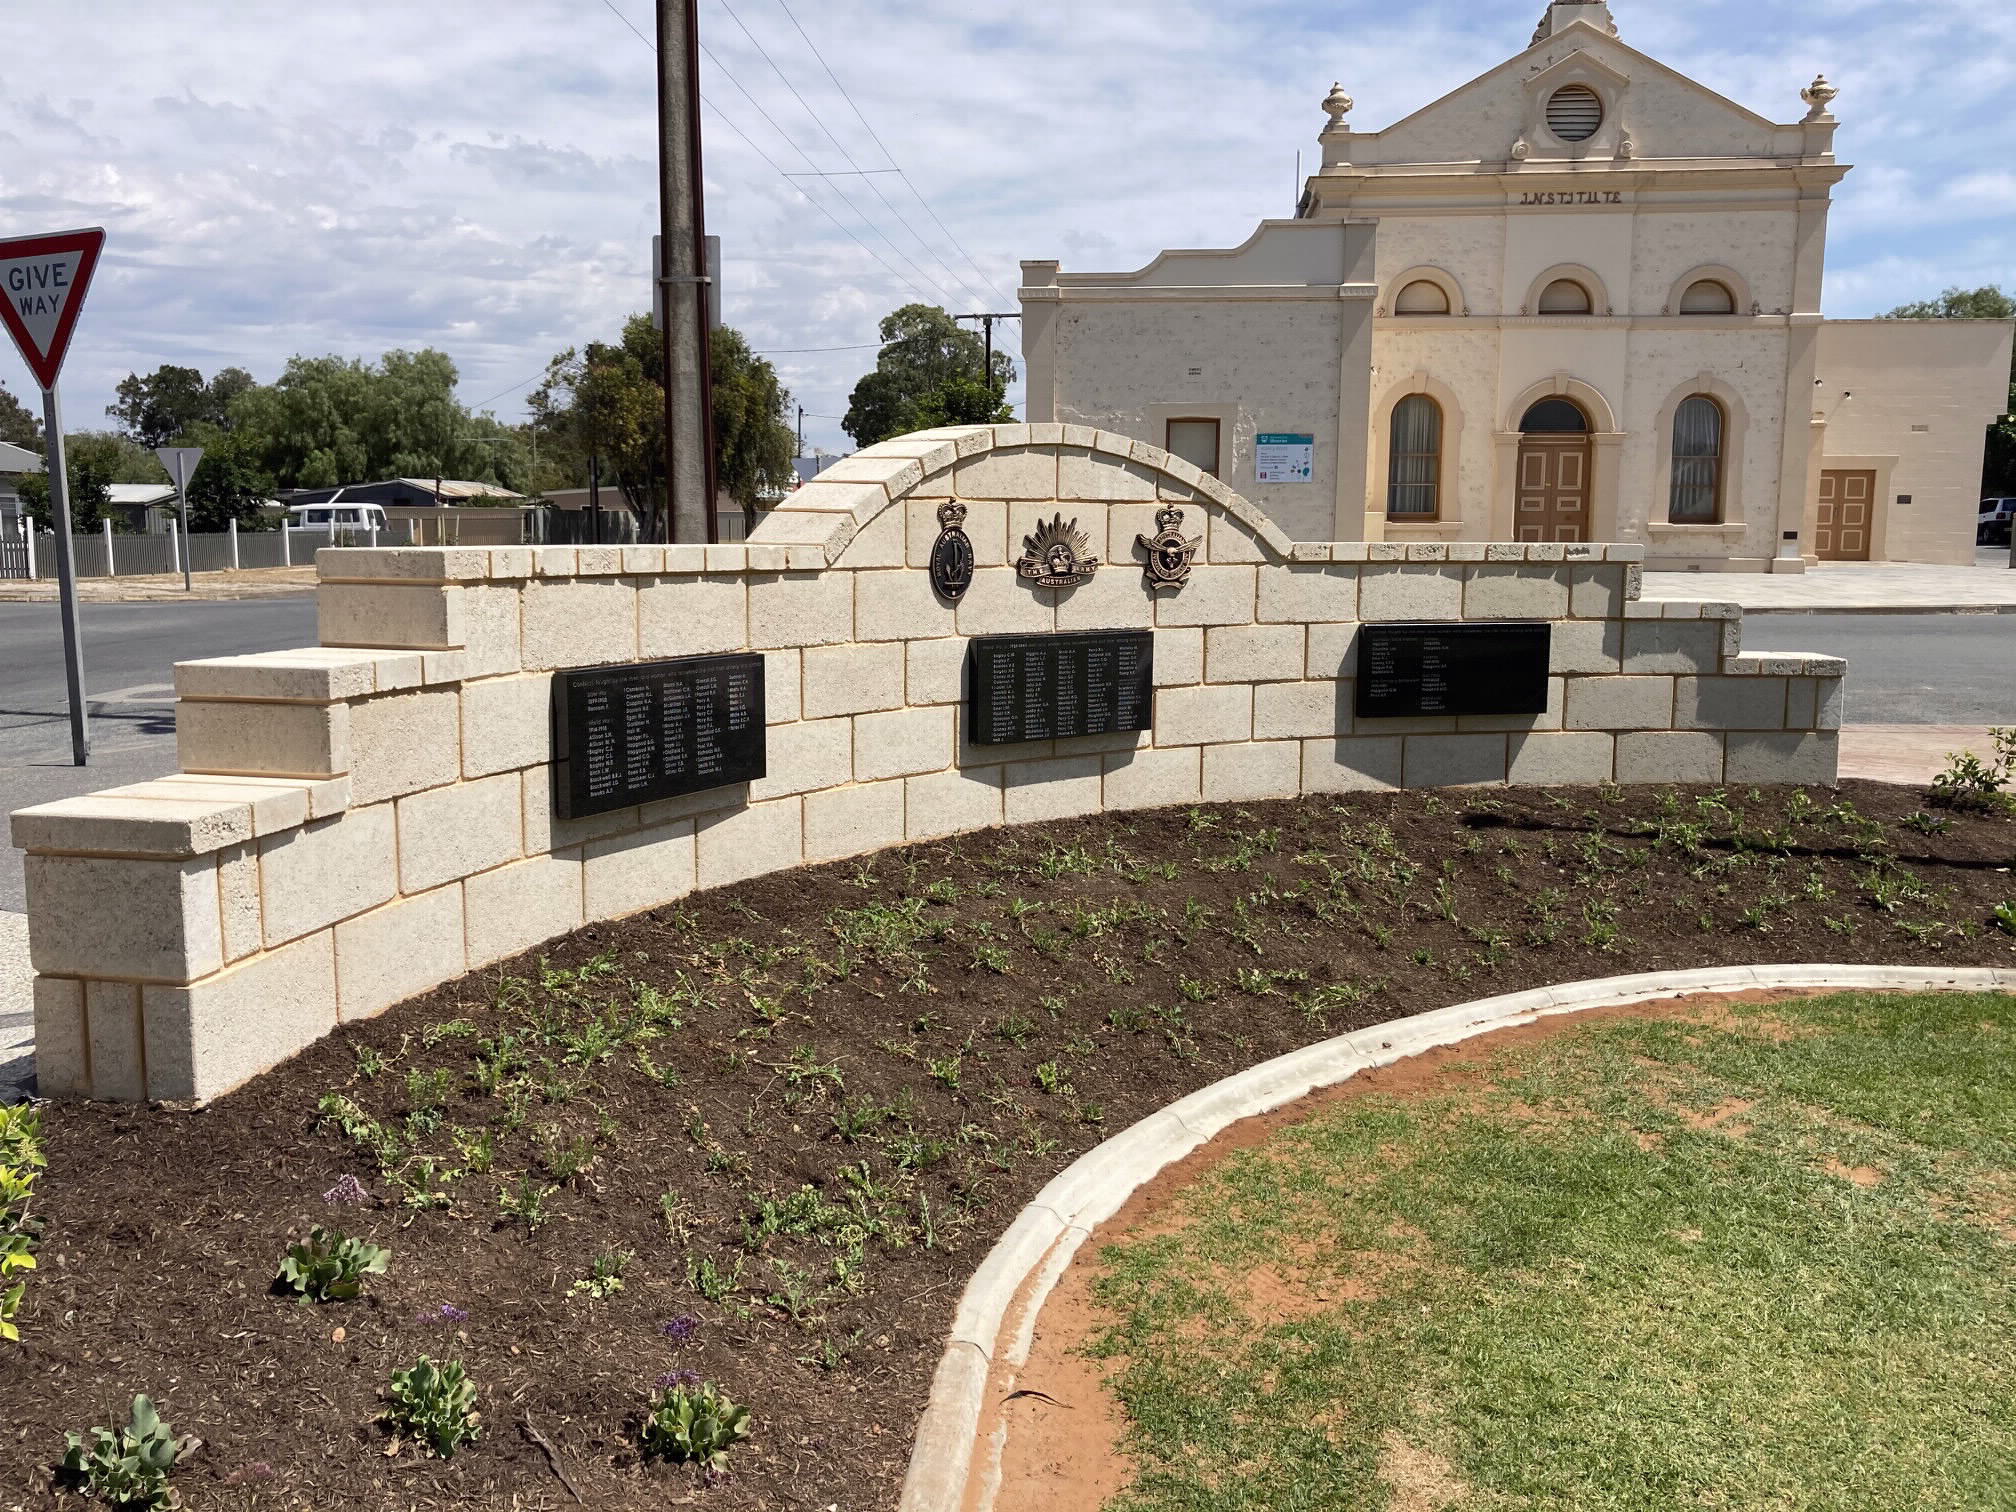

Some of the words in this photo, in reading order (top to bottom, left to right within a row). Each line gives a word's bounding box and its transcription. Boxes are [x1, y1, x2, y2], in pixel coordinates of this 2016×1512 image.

[1520, 191, 1622, 205] INSTITUTE
[9, 262, 68, 292] GIVE
[19, 294, 60, 316] WAY
[1027, 567, 1044, 575] THE
[1041, 574, 1082, 586] AUSTRALIAN
